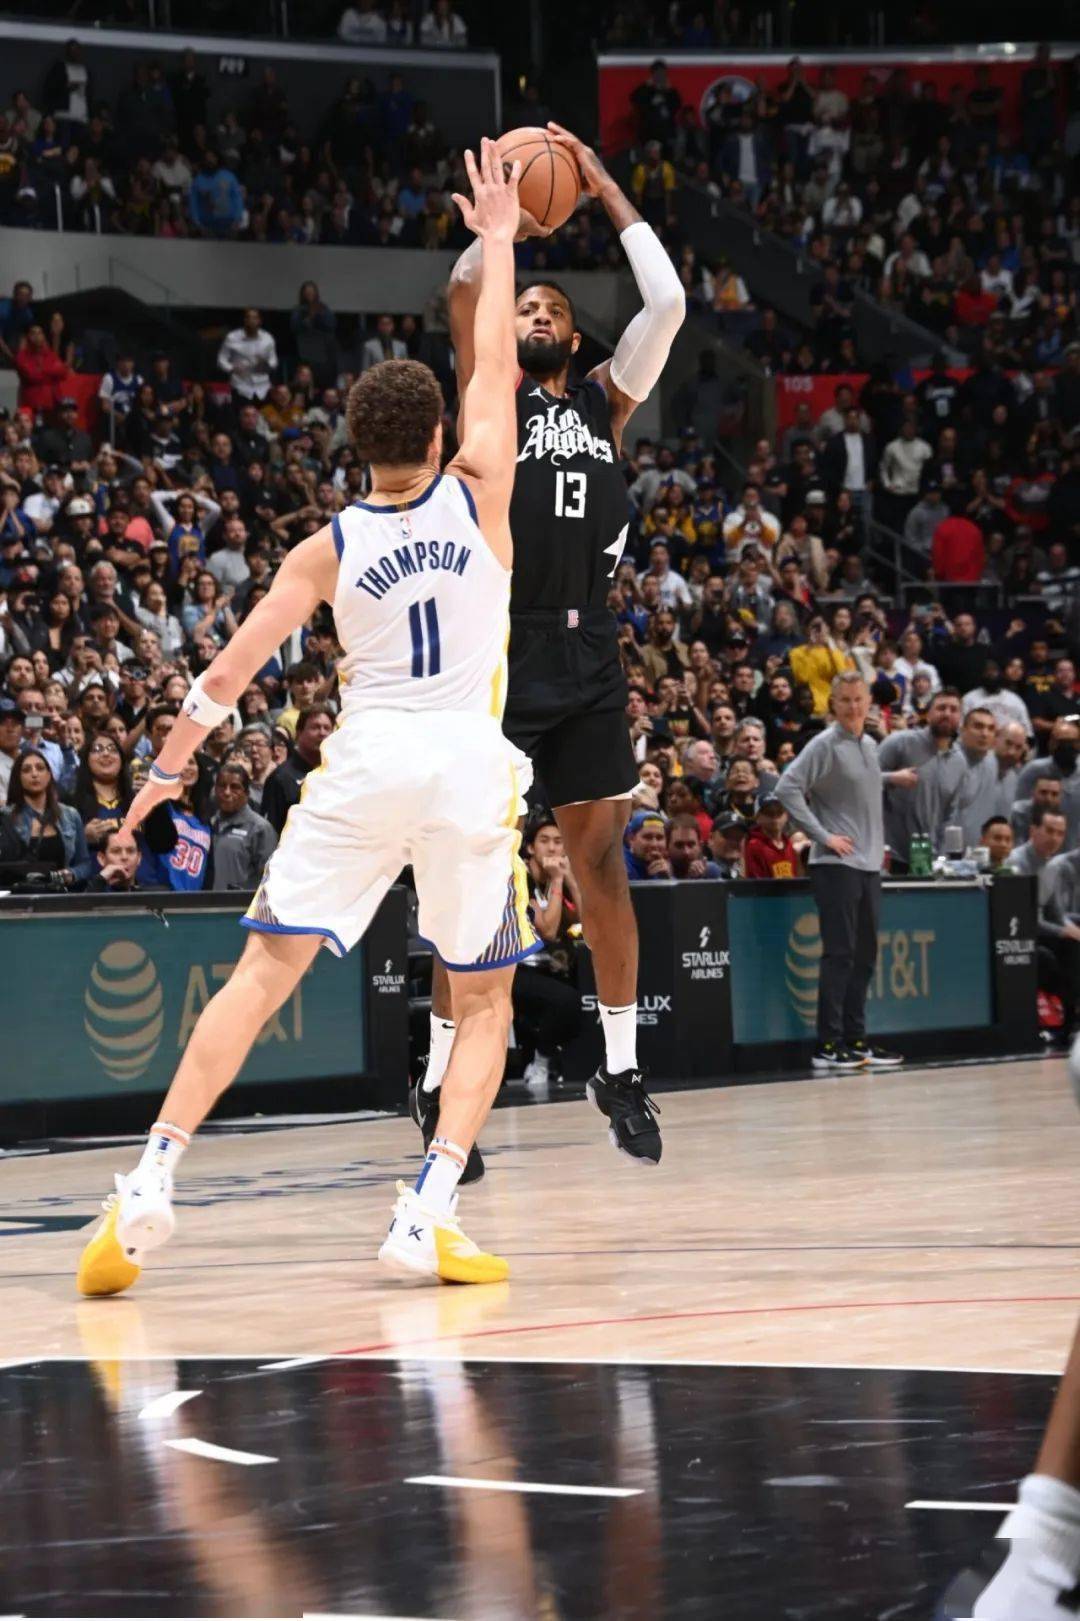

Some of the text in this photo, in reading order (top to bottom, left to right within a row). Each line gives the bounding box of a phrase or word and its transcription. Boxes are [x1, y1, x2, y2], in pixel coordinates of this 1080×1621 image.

[516, 414, 614, 466] Angeles
[544, 404, 582, 433] Los
[555, 471, 587, 518] 13
[355, 540, 472, 600] THOMPSON
[408, 597, 440, 678] 11
[169, 839, 204, 878] 30
[681, 951, 730, 968] STARLUX
[690, 967, 725, 979] AIRLINES
